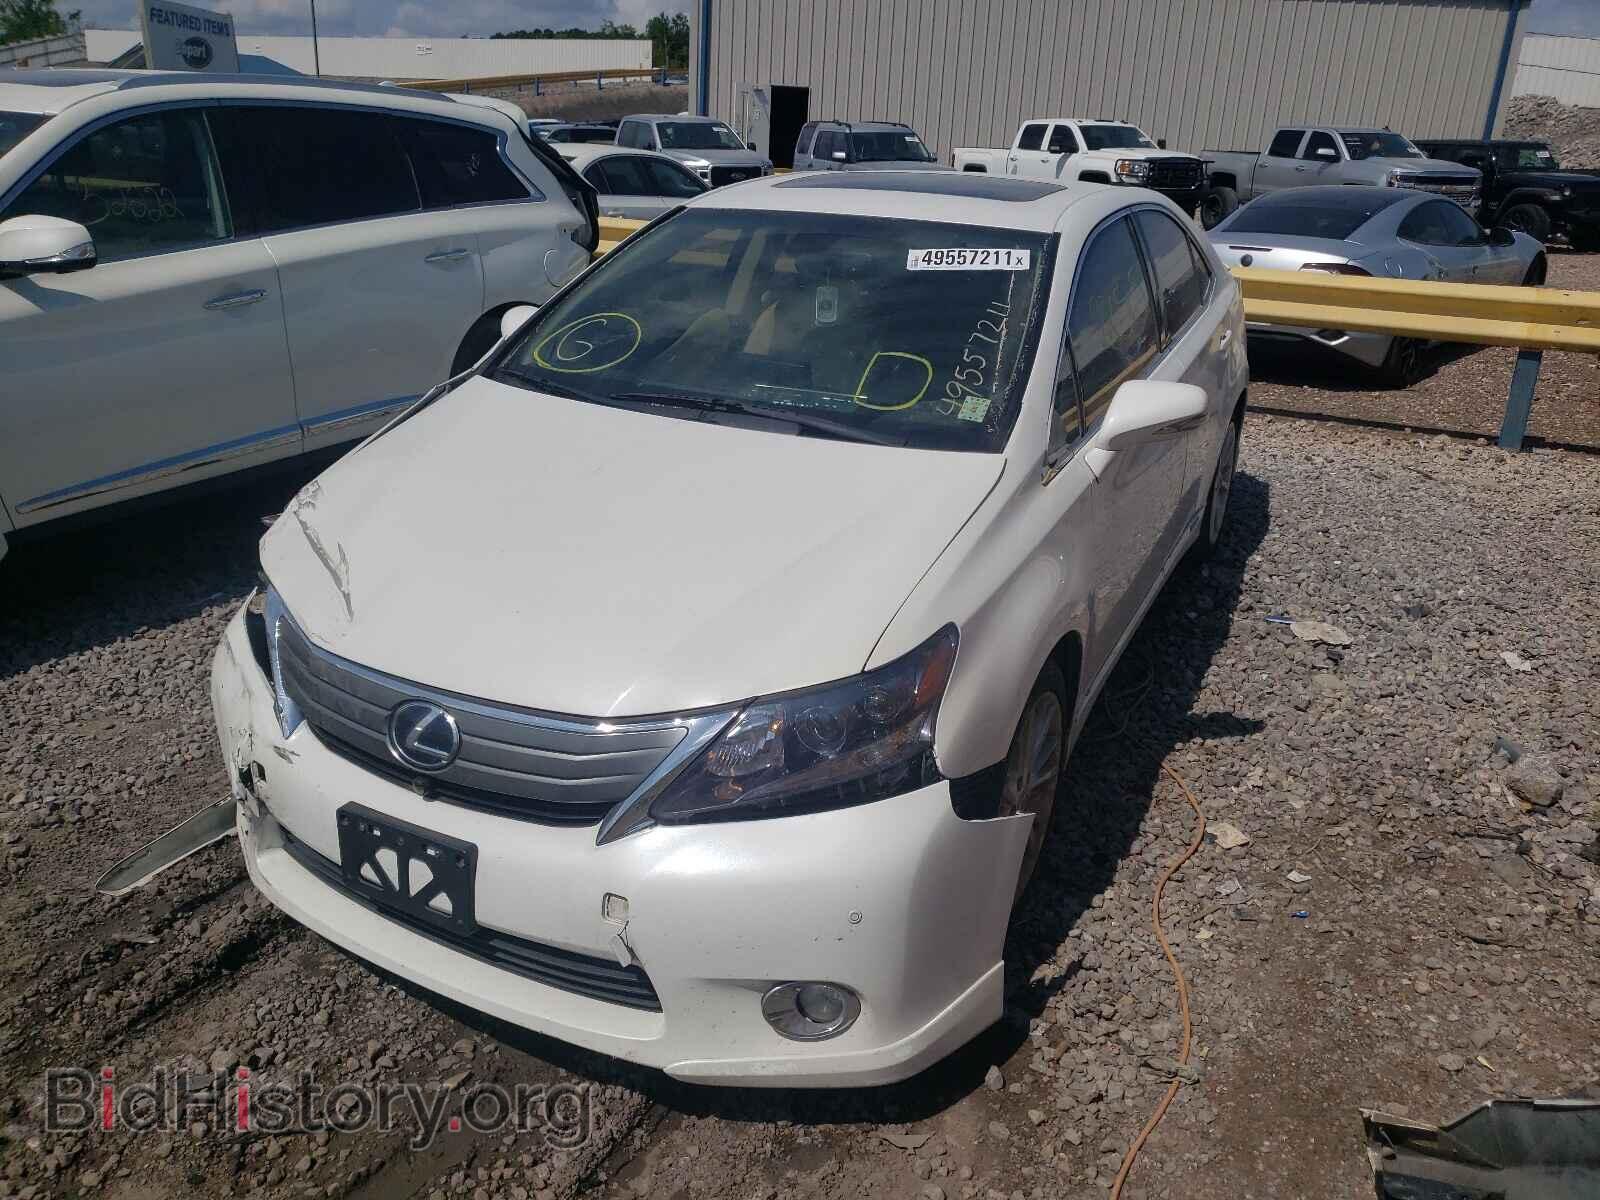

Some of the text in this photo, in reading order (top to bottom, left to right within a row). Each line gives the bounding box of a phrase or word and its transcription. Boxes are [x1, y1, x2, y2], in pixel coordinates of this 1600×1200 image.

[150, 8, 230, 37] FEATURED ITEMS
[922, 249, 1012, 266] 49557211
[936, 300, 1011, 416] 49557211
